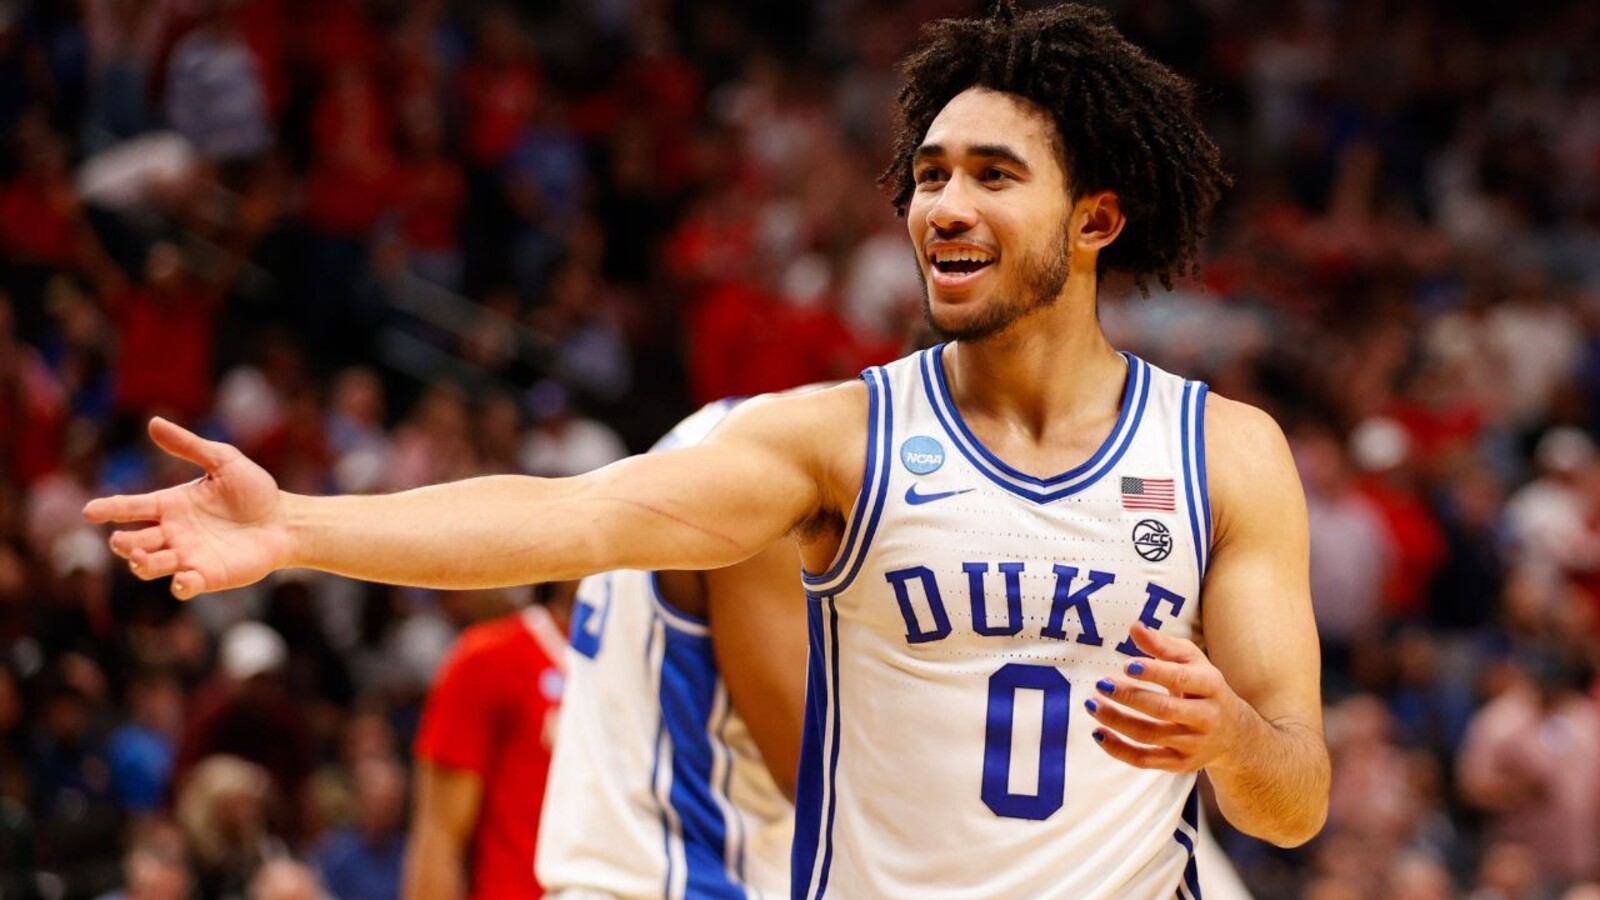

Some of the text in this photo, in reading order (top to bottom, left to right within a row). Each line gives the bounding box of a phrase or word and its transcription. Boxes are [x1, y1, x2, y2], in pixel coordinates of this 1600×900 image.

[905, 451, 943, 465] NCAA
[1138, 532, 1169, 545] ACC
[885, 562, 1186, 660] DUKE
[980, 662, 1072, 821] 0
